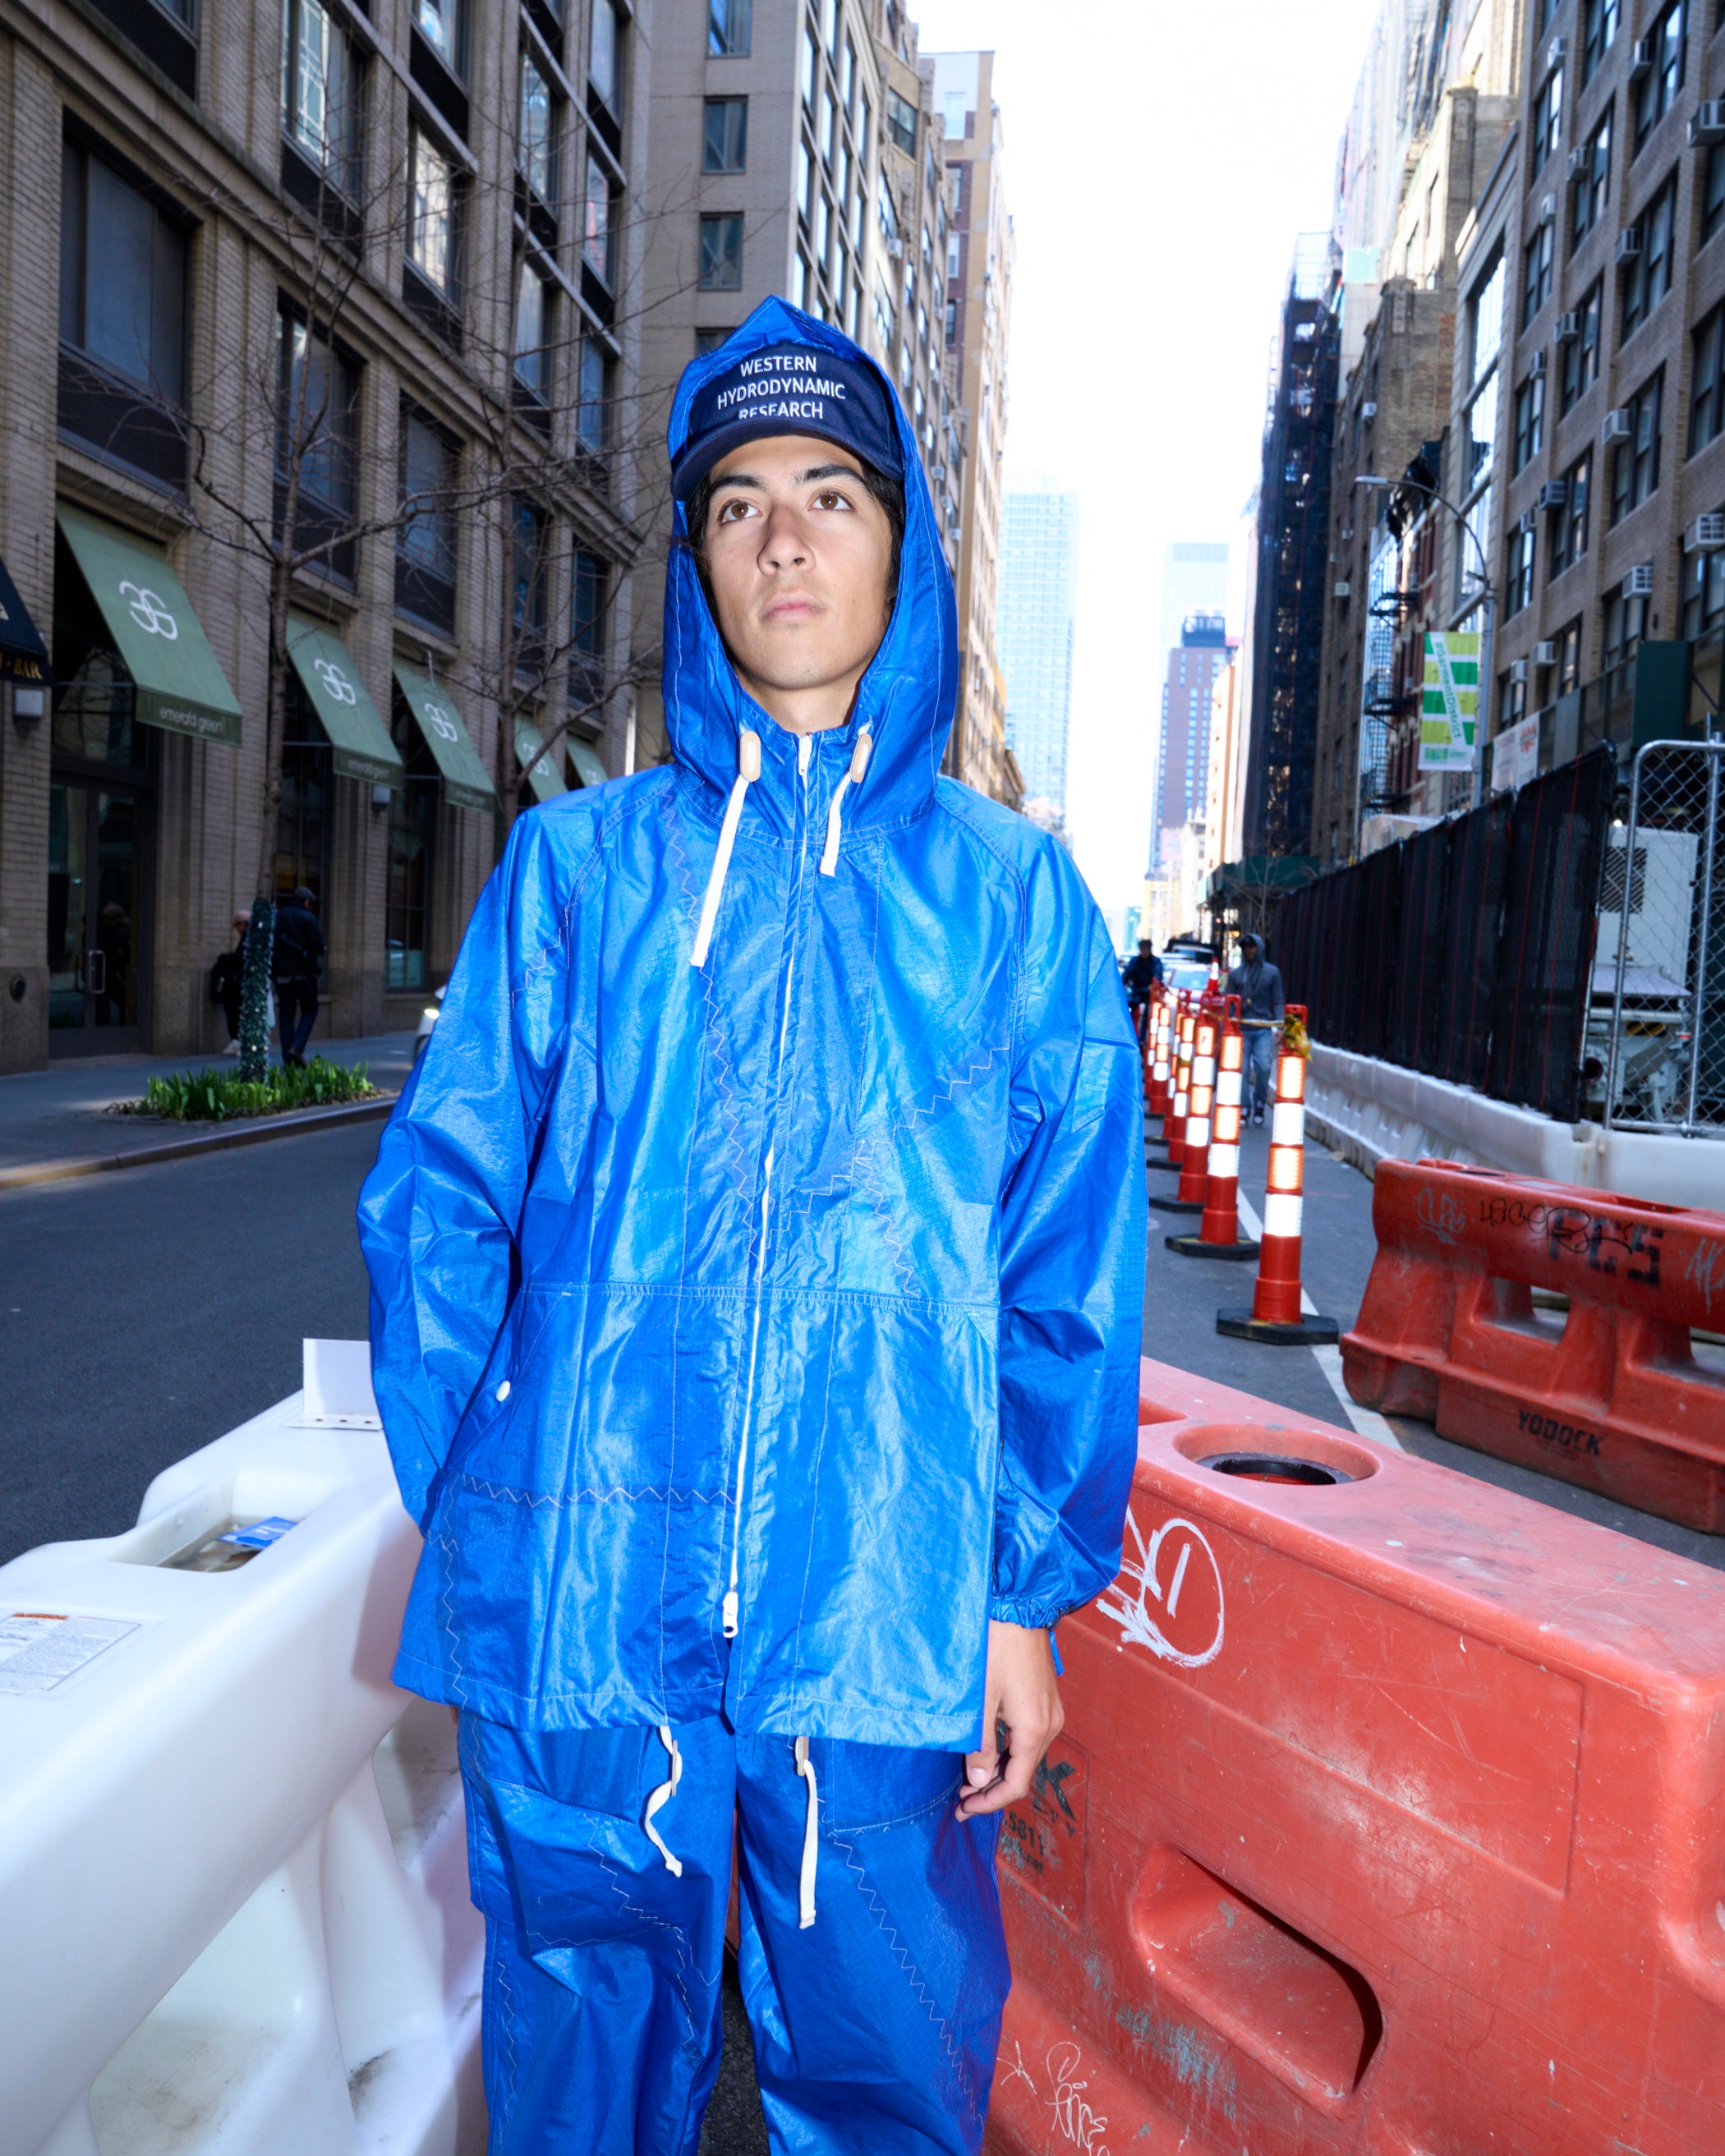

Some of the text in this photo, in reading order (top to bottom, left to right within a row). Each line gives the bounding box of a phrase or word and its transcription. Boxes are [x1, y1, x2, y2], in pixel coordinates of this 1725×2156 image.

[740, 356, 816, 377] WESTERN
[717, 377, 846, 410] HYDRODYNAMIC
[159, 706, 223, 733] emerald green
[1518, 1409, 1603, 1456] YODOCK
